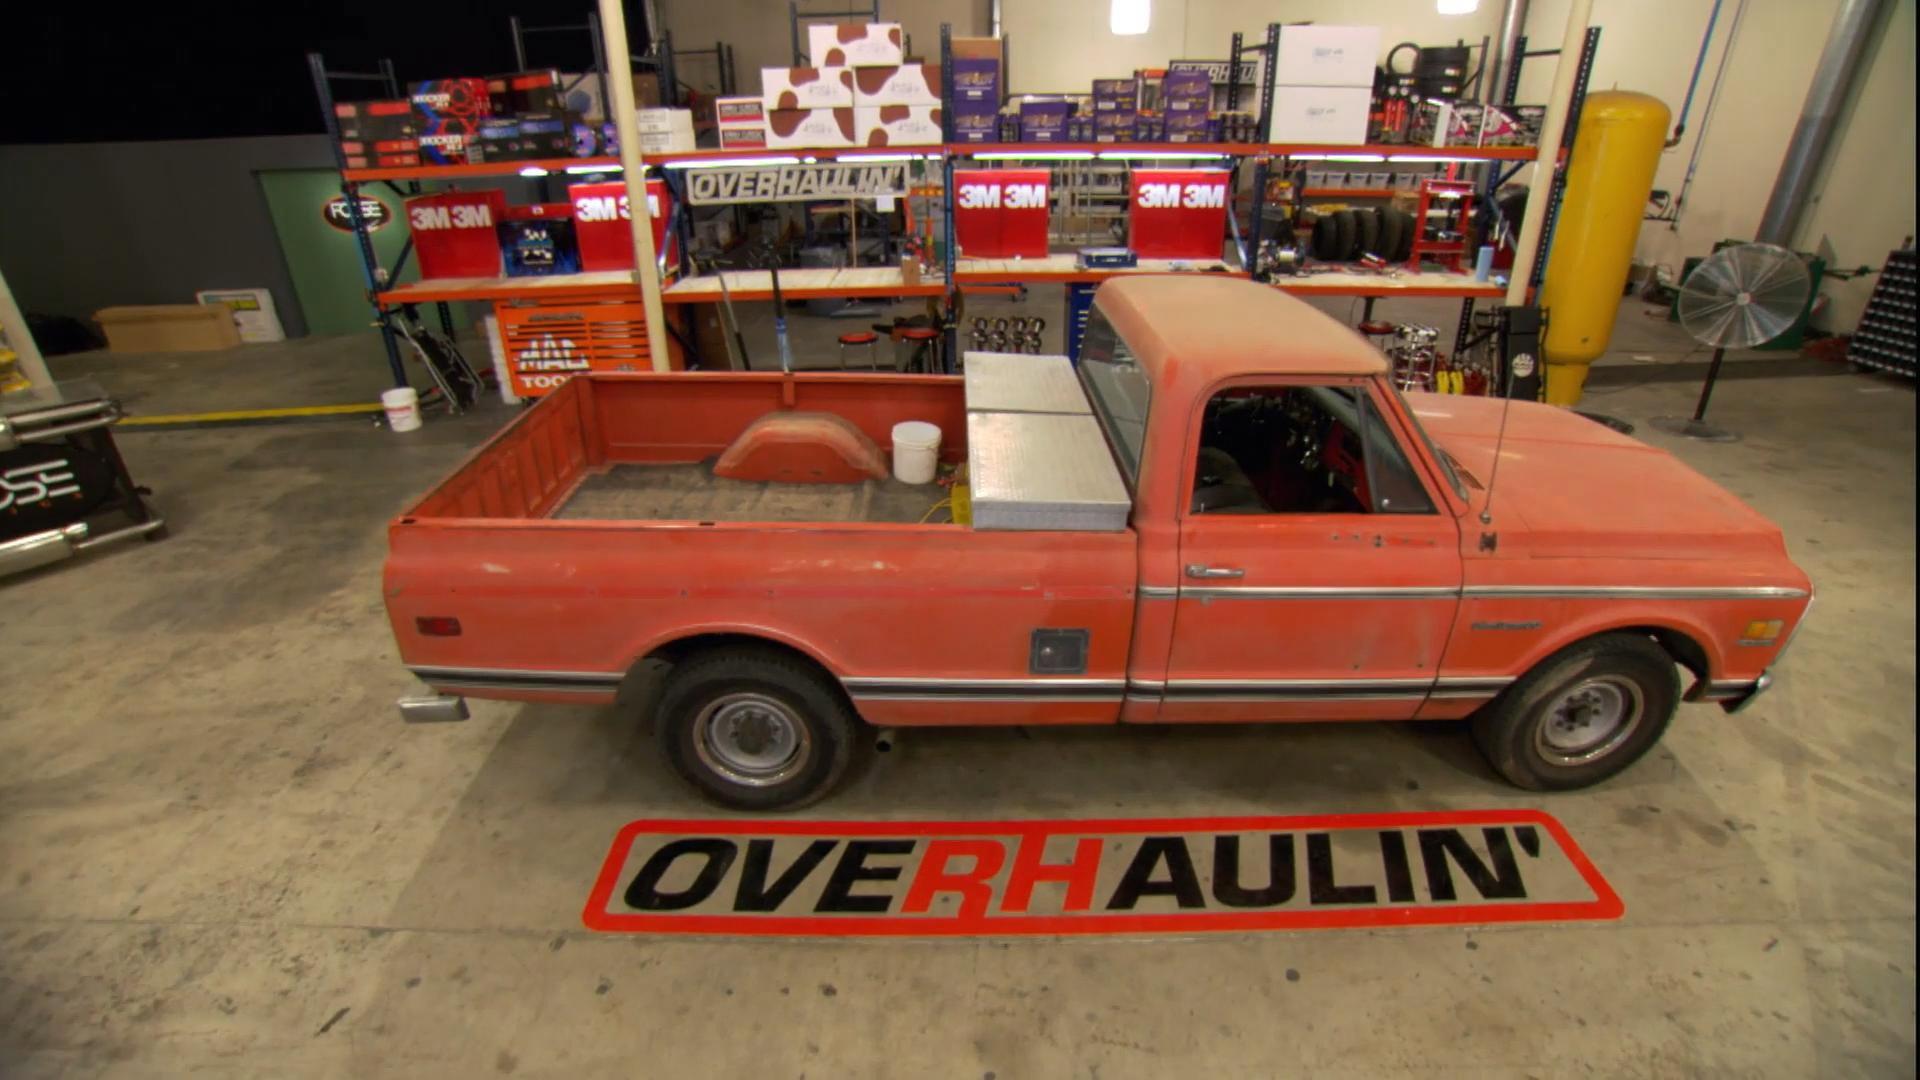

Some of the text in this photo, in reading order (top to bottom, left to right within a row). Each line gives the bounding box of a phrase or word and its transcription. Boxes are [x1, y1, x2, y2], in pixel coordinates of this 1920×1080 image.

[958, 184, 1046, 208] 3M 3M
[1137, 183, 1225, 208] 3M 3M
[411, 204, 492, 229] 3M 3M
[576, 196, 618, 221] 3M
[518, 333, 591, 371] MAC
[519, 374, 572, 389] TOO
[623, 825, 1541, 914] OVERHAULIN'
